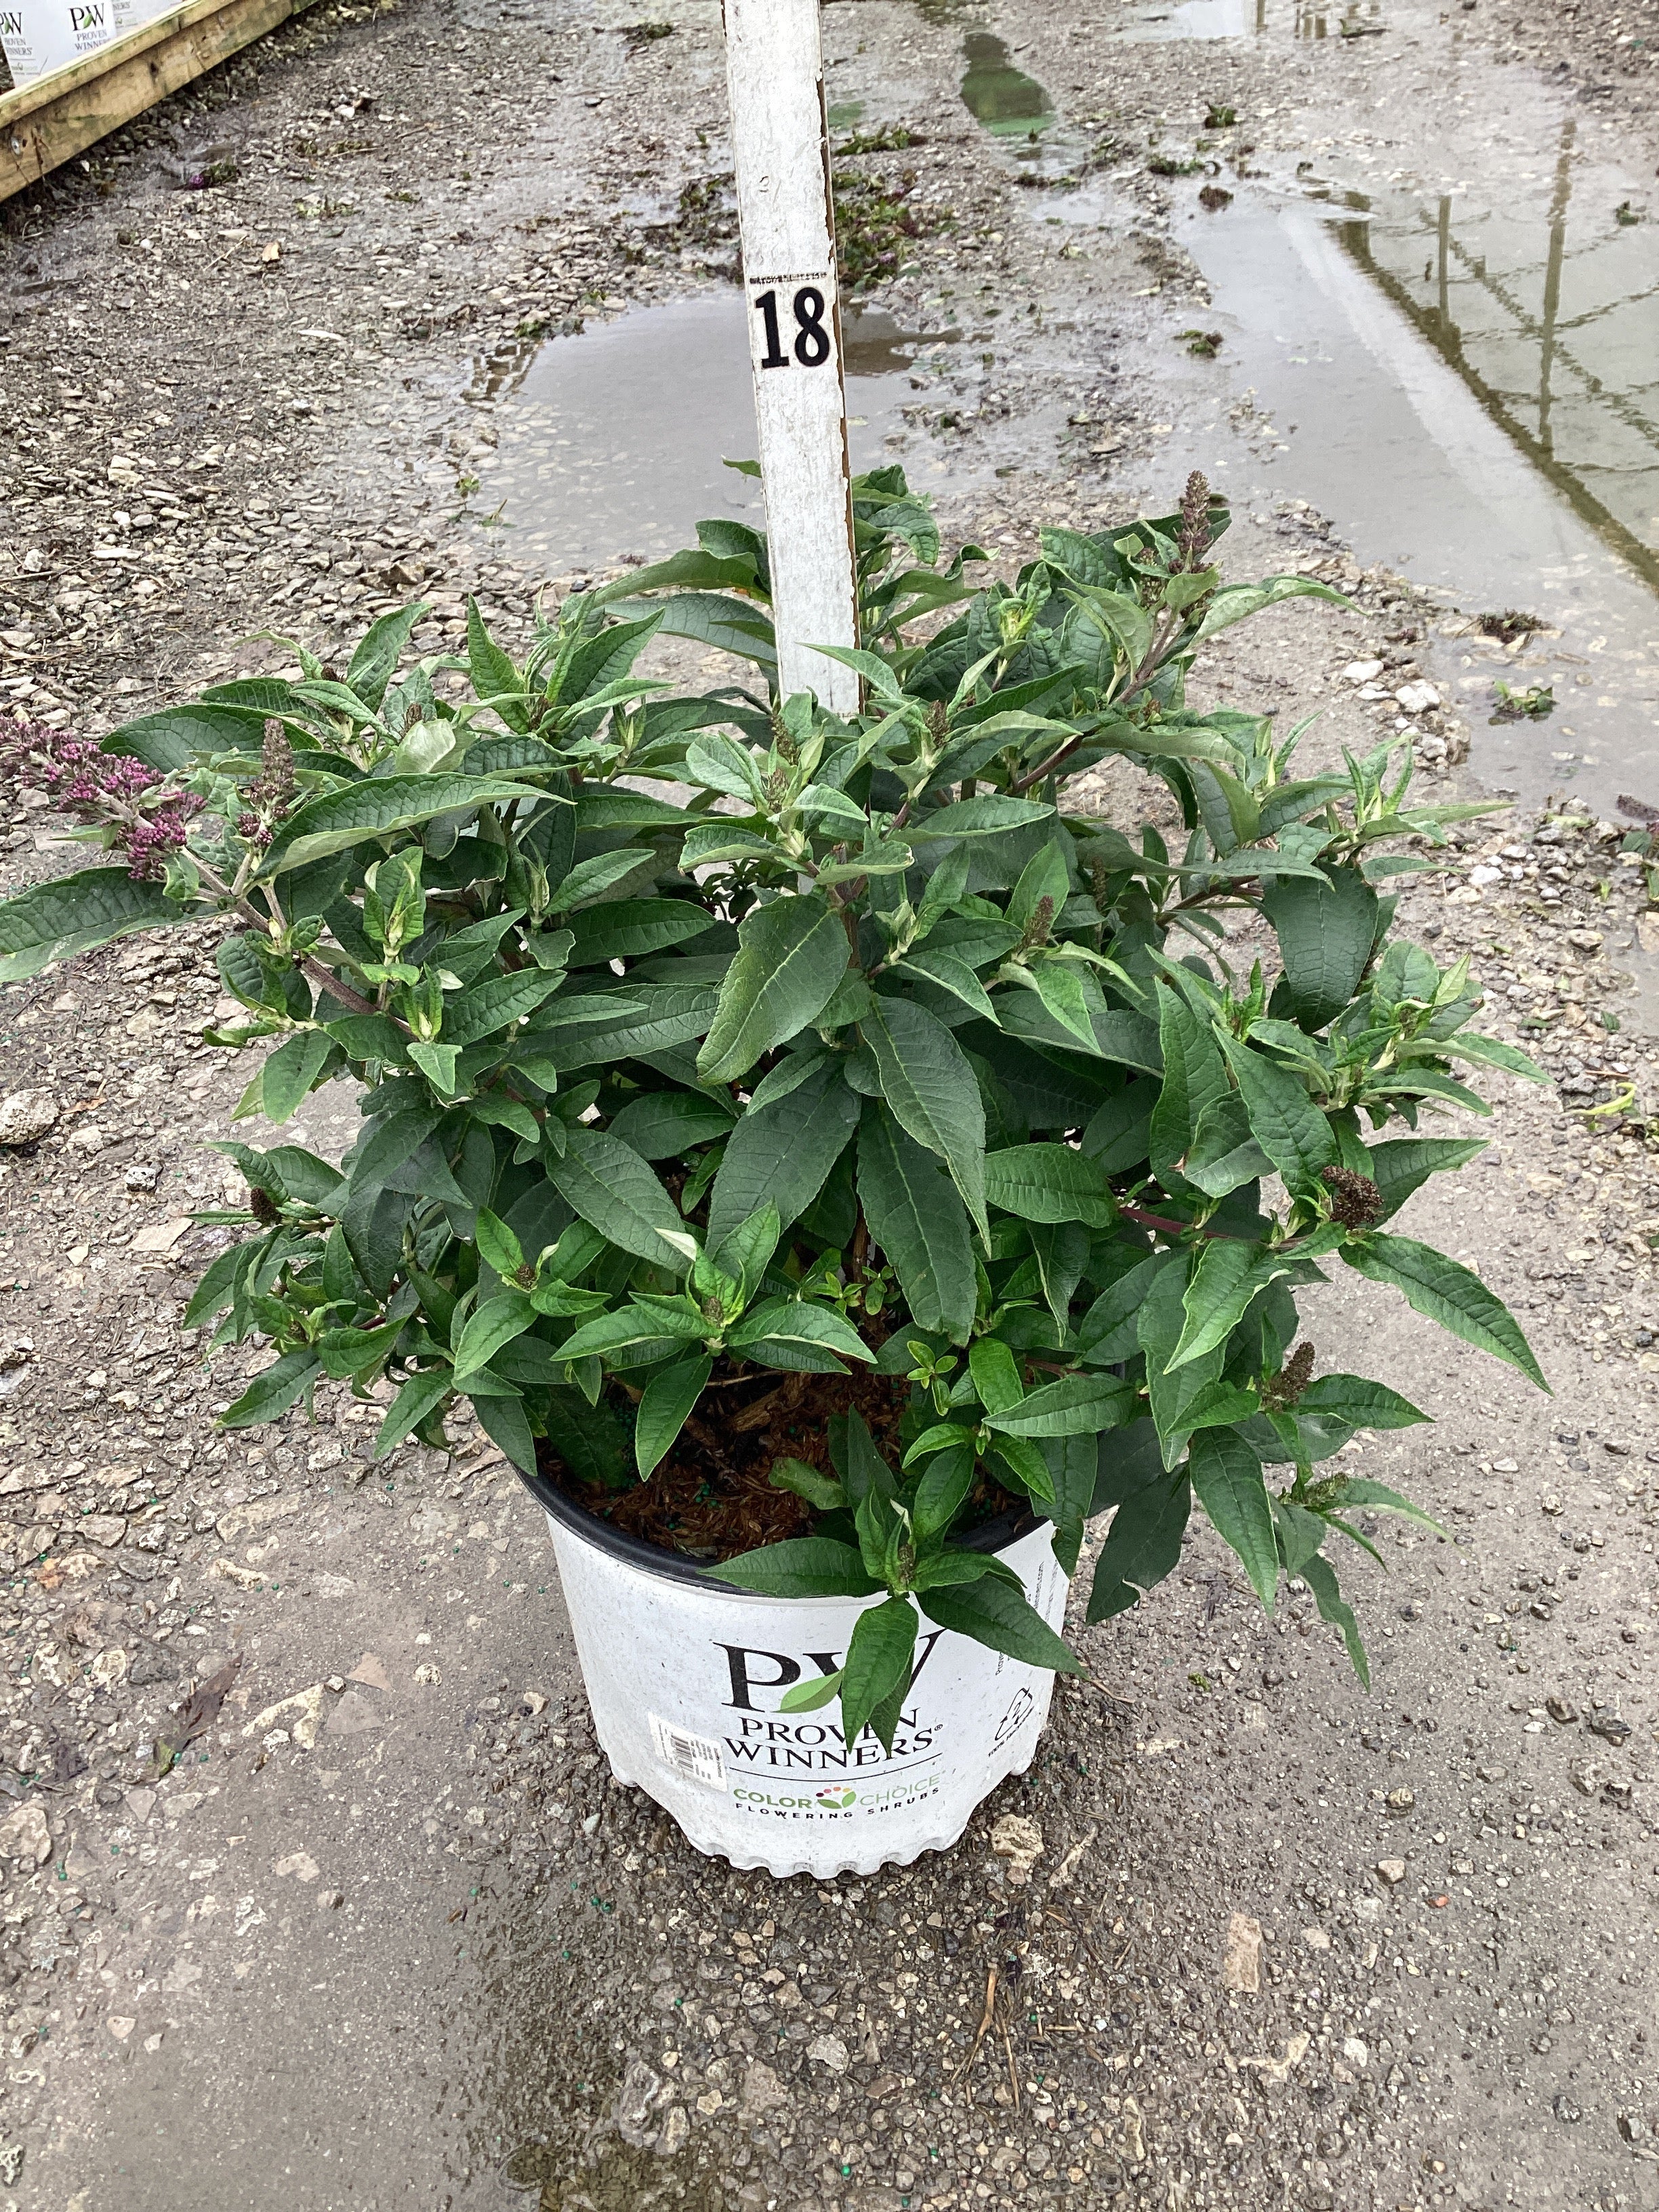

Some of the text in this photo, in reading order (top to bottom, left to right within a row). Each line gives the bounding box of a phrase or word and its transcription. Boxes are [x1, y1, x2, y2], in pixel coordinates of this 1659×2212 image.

[67, 3, 104, 31] PW
[754, 287, 830, 369] 18
[733, 1771, 941, 1809] COLOR CHOICE
[735, 1786, 940, 1820] FLOWERING SHRUBS
